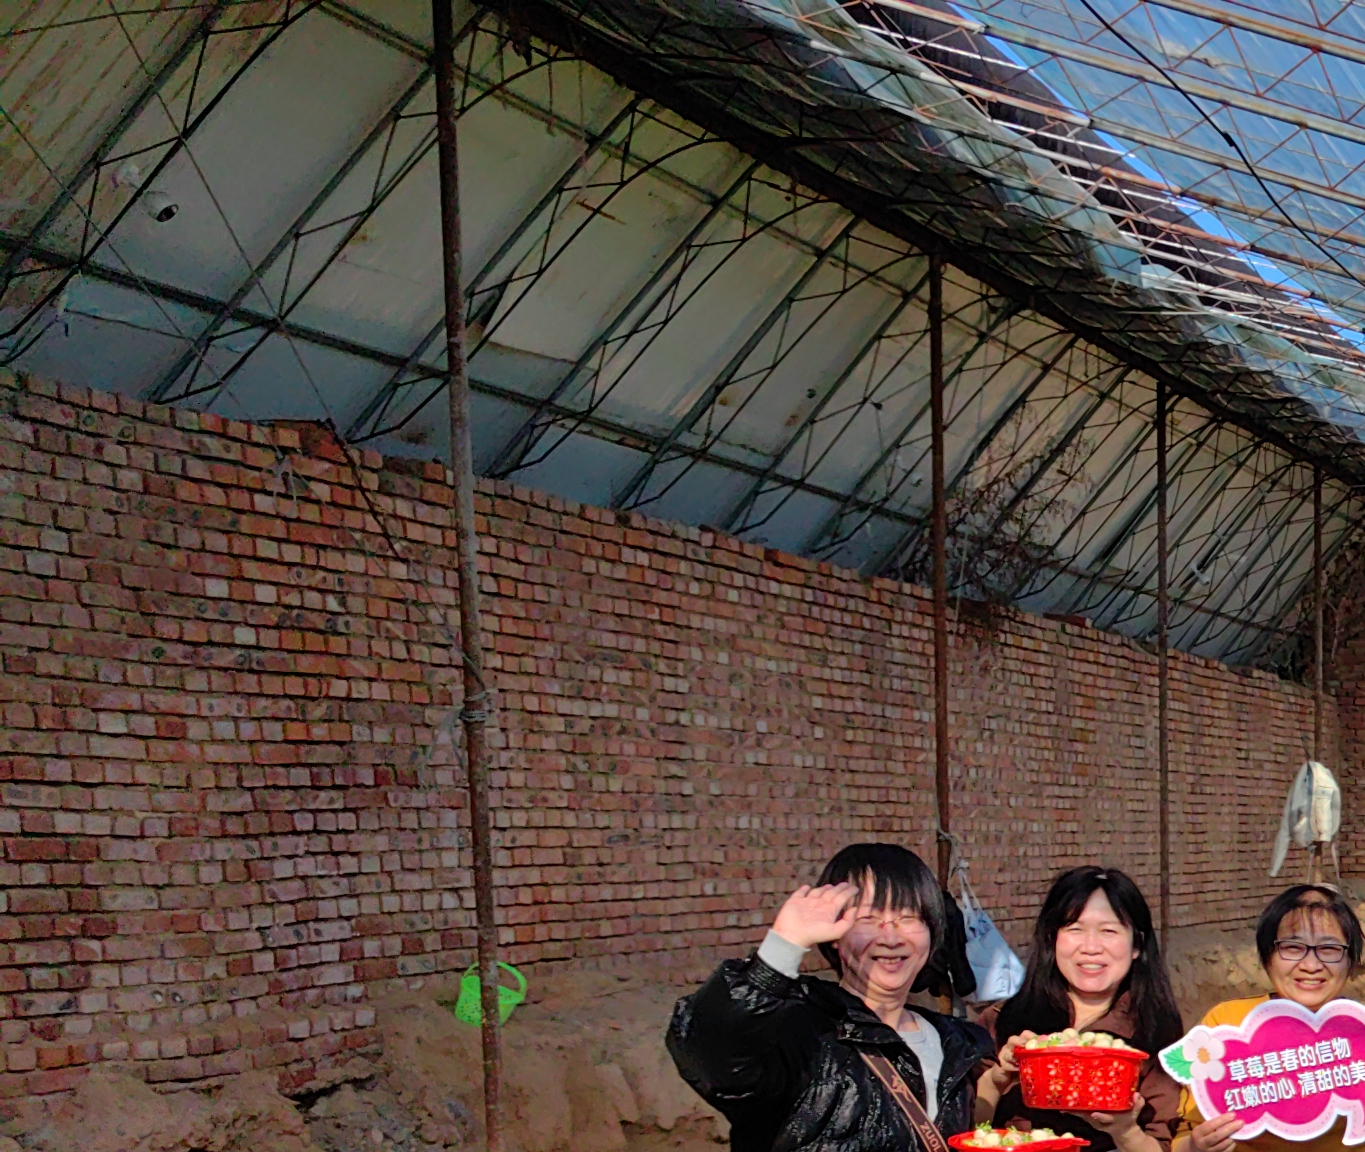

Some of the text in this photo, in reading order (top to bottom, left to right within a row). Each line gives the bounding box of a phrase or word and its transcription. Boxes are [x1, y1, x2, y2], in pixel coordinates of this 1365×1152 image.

[1227, 1036, 1351, 1084] 草莓是春的信物
[1223, 1077, 1296, 1113] 红嫩的心
